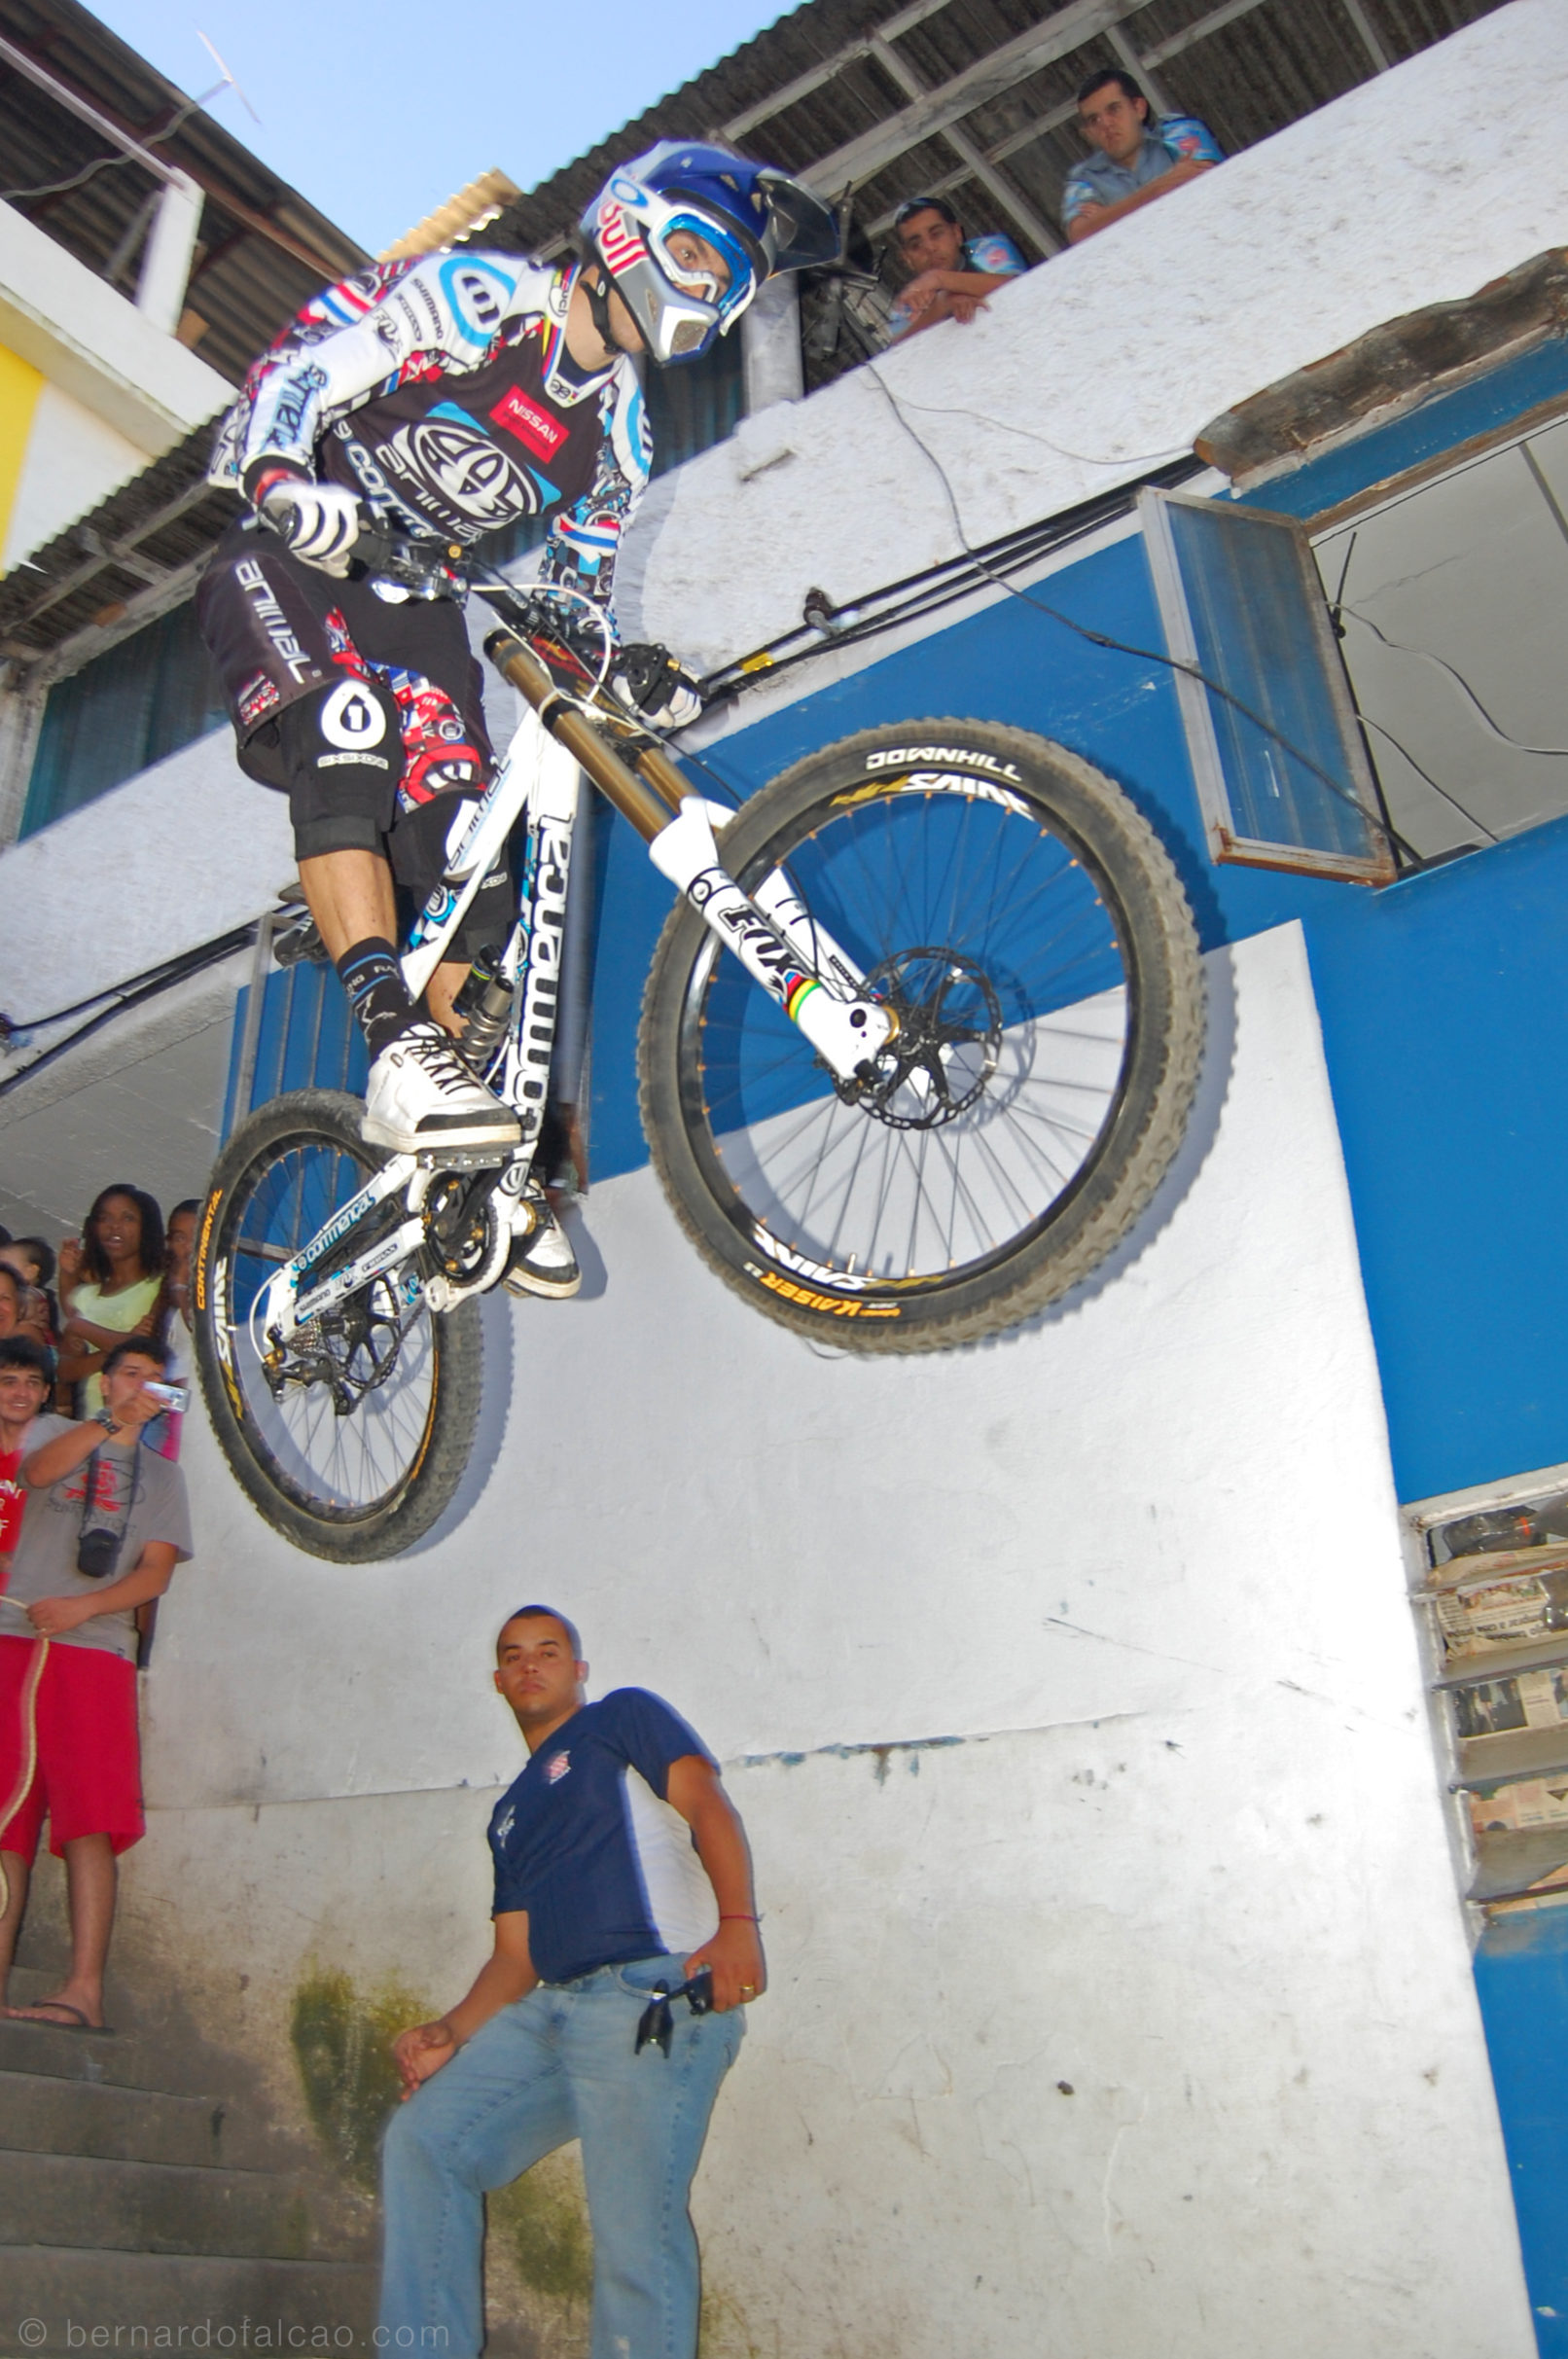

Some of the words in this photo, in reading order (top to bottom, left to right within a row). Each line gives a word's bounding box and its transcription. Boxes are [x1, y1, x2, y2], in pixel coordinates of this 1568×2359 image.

[508, 398, 558, 445] NISSAN
[866, 746, 1023, 782] DOWNHILL
[196, 1188, 224, 1311] CONTINENTAL
[759, 1269, 864, 1318] KAISER
